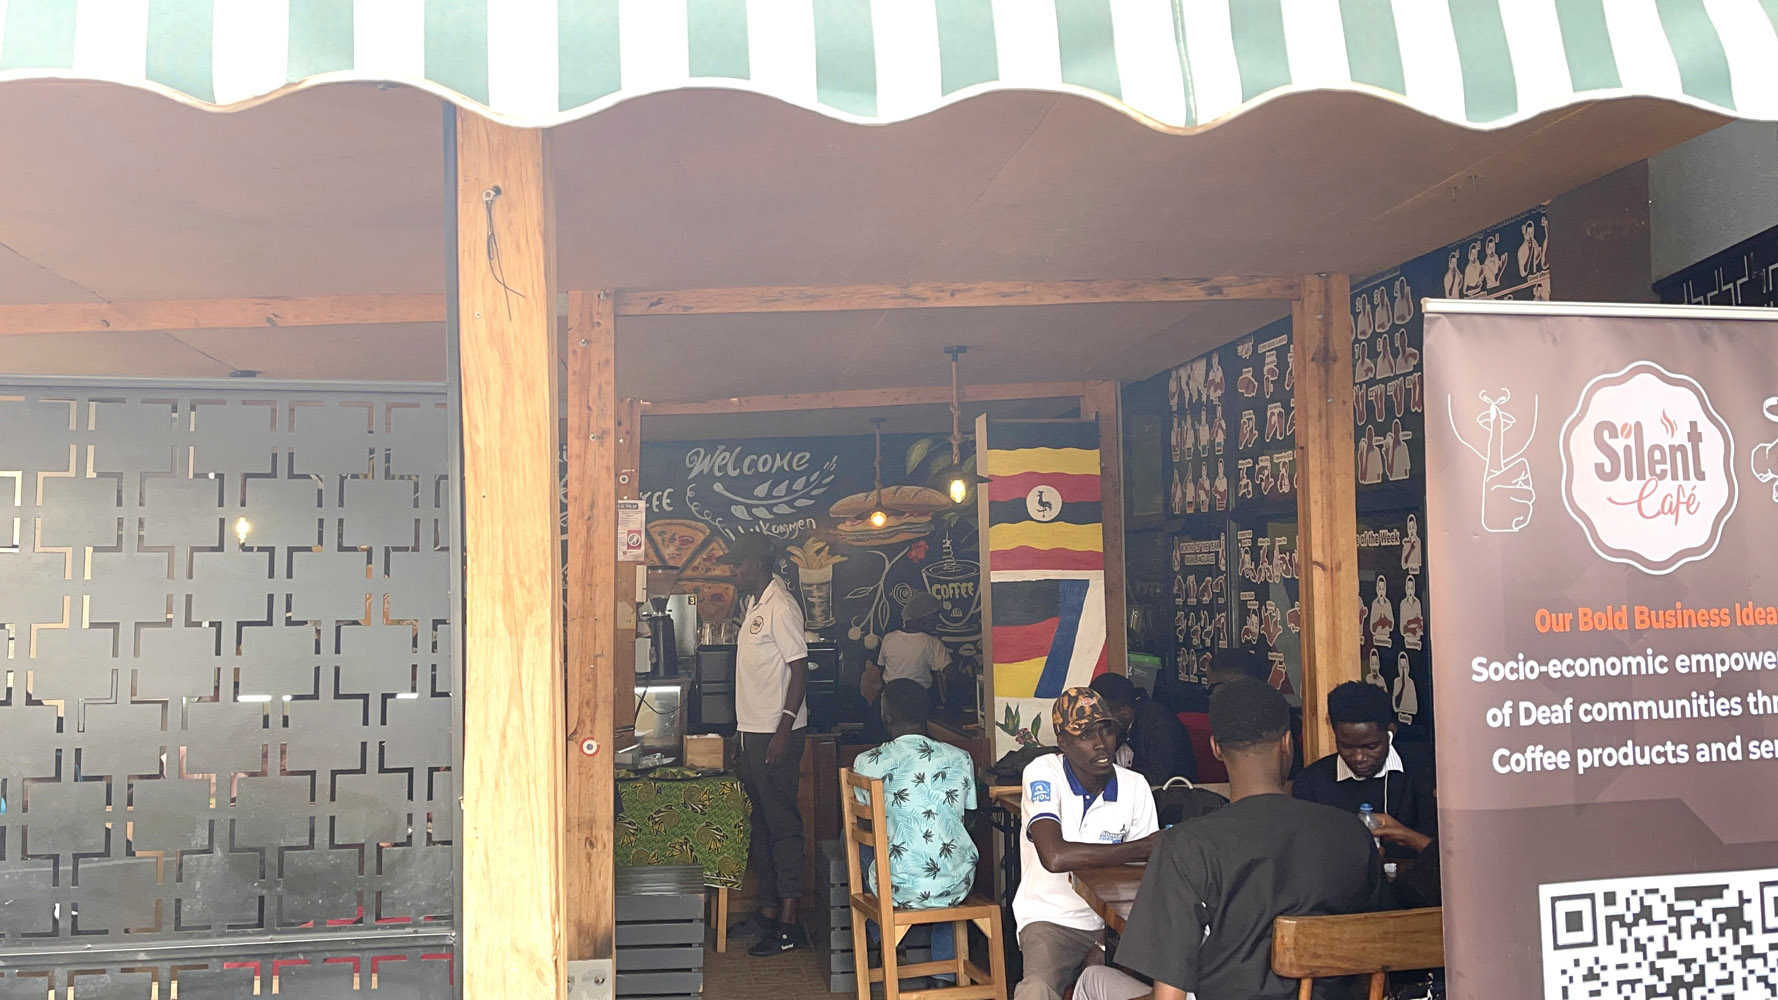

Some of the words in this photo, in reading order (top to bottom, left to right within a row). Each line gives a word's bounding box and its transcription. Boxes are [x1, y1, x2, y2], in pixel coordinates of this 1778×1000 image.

[685, 444, 811, 480] Welcome
[1594, 420, 1706, 482] Silent
[1606, 476, 1700, 526] Café
[1360, 532, 1367, 546] of
[1368, 531, 1379, 545] the
[1380, 530, 1399, 544] Week
[931, 582, 974, 600] COFFEE
[1535, 608, 1573, 633] Our
[1578, 605, 1628, 632] Bold
[1634, 602, 1731, 630] Business
[1735, 601, 1778, 627] Idea
[1471, 648, 1669, 682] Socio-economic
[1675, 651, 1778, 678] empowe
[1486, 700, 1514, 728] of
[1519, 697, 1574, 726] Deaf
[1578, 690, 1742, 723] communities
[1492, 745, 1570, 774] Coffee
[1576, 739, 1689, 775] products
[1695, 735, 1742, 763] and
